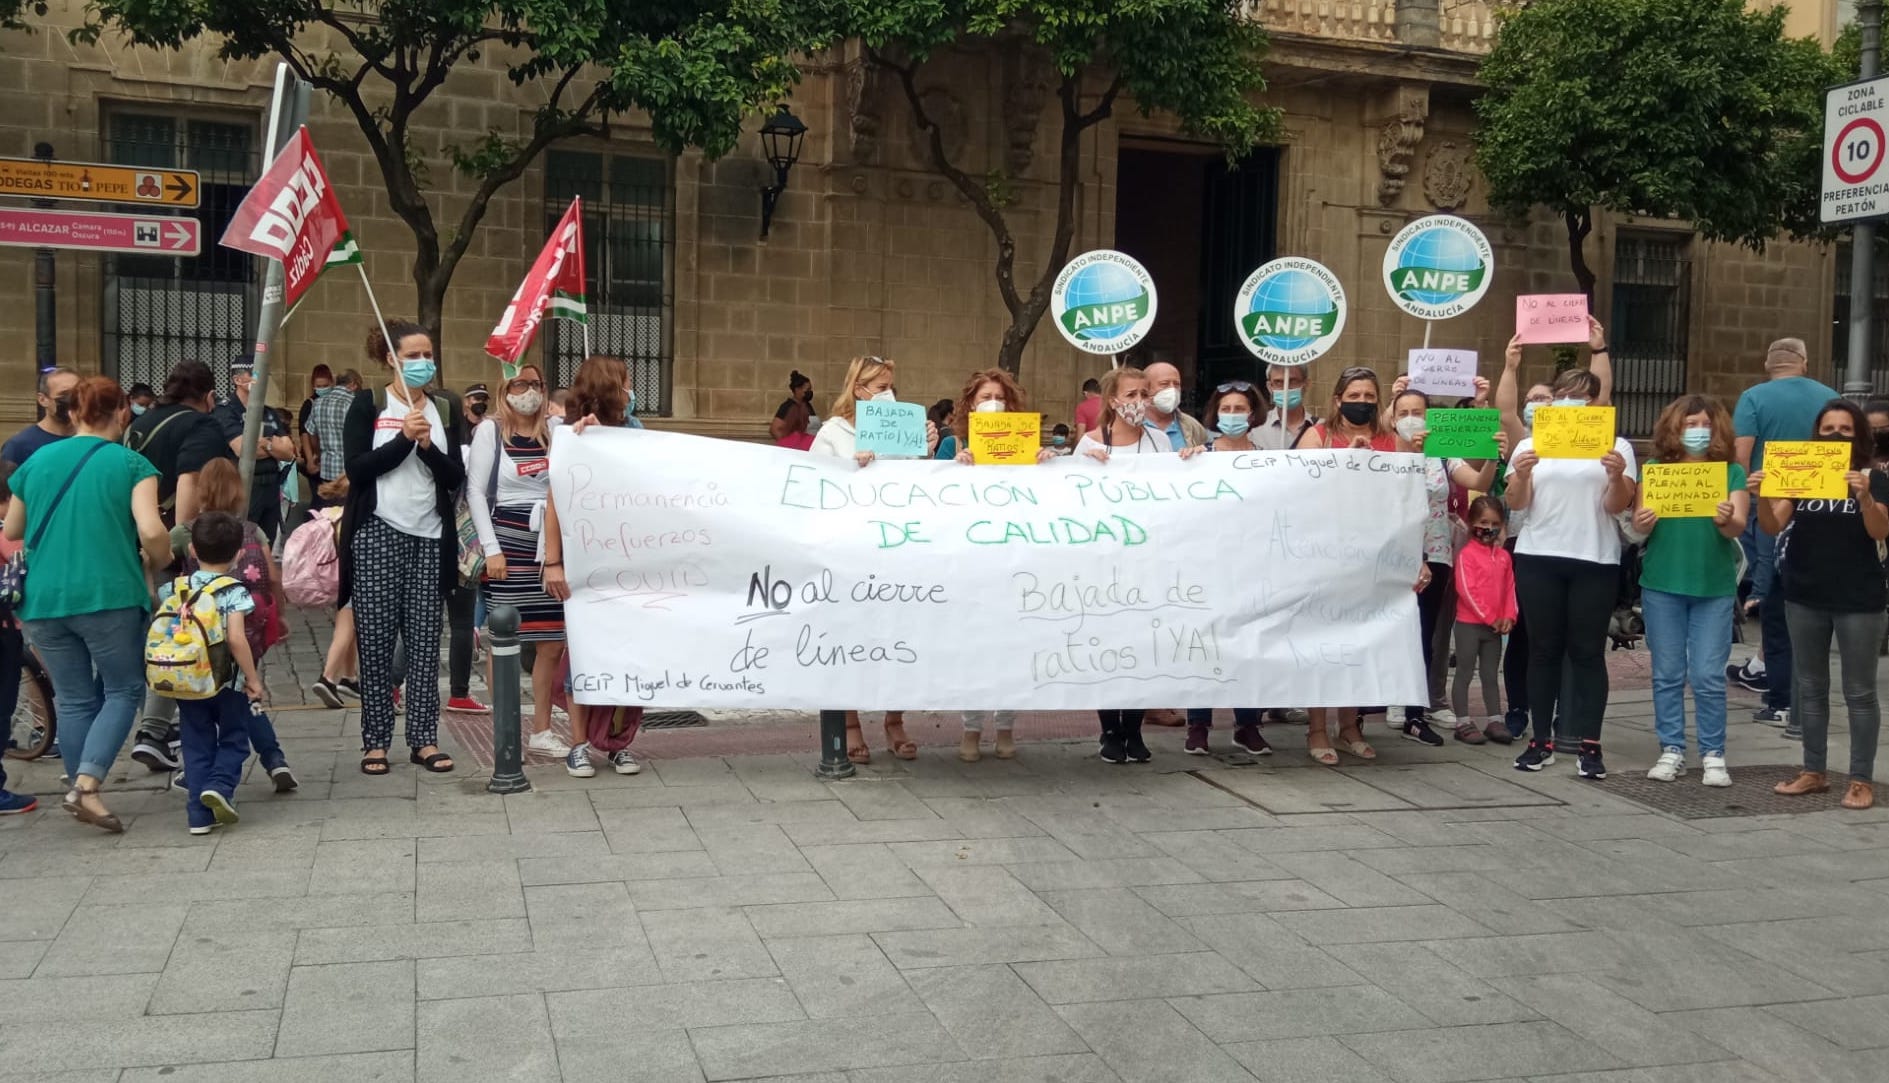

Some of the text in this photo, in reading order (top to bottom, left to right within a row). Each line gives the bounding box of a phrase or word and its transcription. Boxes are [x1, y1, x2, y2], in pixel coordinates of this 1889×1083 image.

[1848, 86, 1875, 100] ZONA
[1838, 98, 1884, 117] CICLABLE
[1848, 140, 1870, 162] 10
[58, 181, 81, 191] TIO
[96, 183, 128, 194] PEPE
[1823, 183, 1889, 202] PREFERENCIA
[1836, 198, 1875, 215] PEATÓN
[19, 222, 69, 234] ALCAZAR
[1392, 219, 1490, 258] SINDICATO INDEPENDIENTE
[1055, 253, 1150, 295] SINDICATO INDEPENDIENTE
[1242, 261, 1343, 302] SINDICATO INDEPENDIENTE
[1401, 269, 1470, 292] ANPE
[1074, 303, 1138, 330] ANPE
[1404, 302, 1465, 318] ANDALUCÍA
[1253, 314, 1322, 336] ANPE
[1082, 332, 1140, 353] ANDALUCÍA
[1257, 349, 1318, 364] ANDALUCÍA
[1445, 354, 1461, 363] AL
[865, 405, 914, 417] BAJADA
[1287, 453, 1338, 479] Miguel
[1345, 454, 1362, 472] de
[1367, 454, 1427, 476] Cervantes
[1646, 464, 1712, 477] ATENCIÓN
[567, 463, 729, 514] Permanencia
[781, 464, 1244, 510] EDUCACIÓN PÚBLICA
[1649, 478, 1714, 489] PLENA AL
[1646, 490, 1721, 500] ALUMNADO
[1660, 503, 1695, 514] NEE
[573, 518, 712, 561] Refuerzos
[867, 515, 1148, 549] DE CALIDAD
[801, 568, 839, 604] al
[850, 573, 948, 605] cierre
[1012, 565, 1207, 635] Bajada de
[730, 624, 918, 673] de líneas
[1032, 631, 1137, 682] ratios
[572, 670, 766, 700] CEIP Miguel de Cervantes
